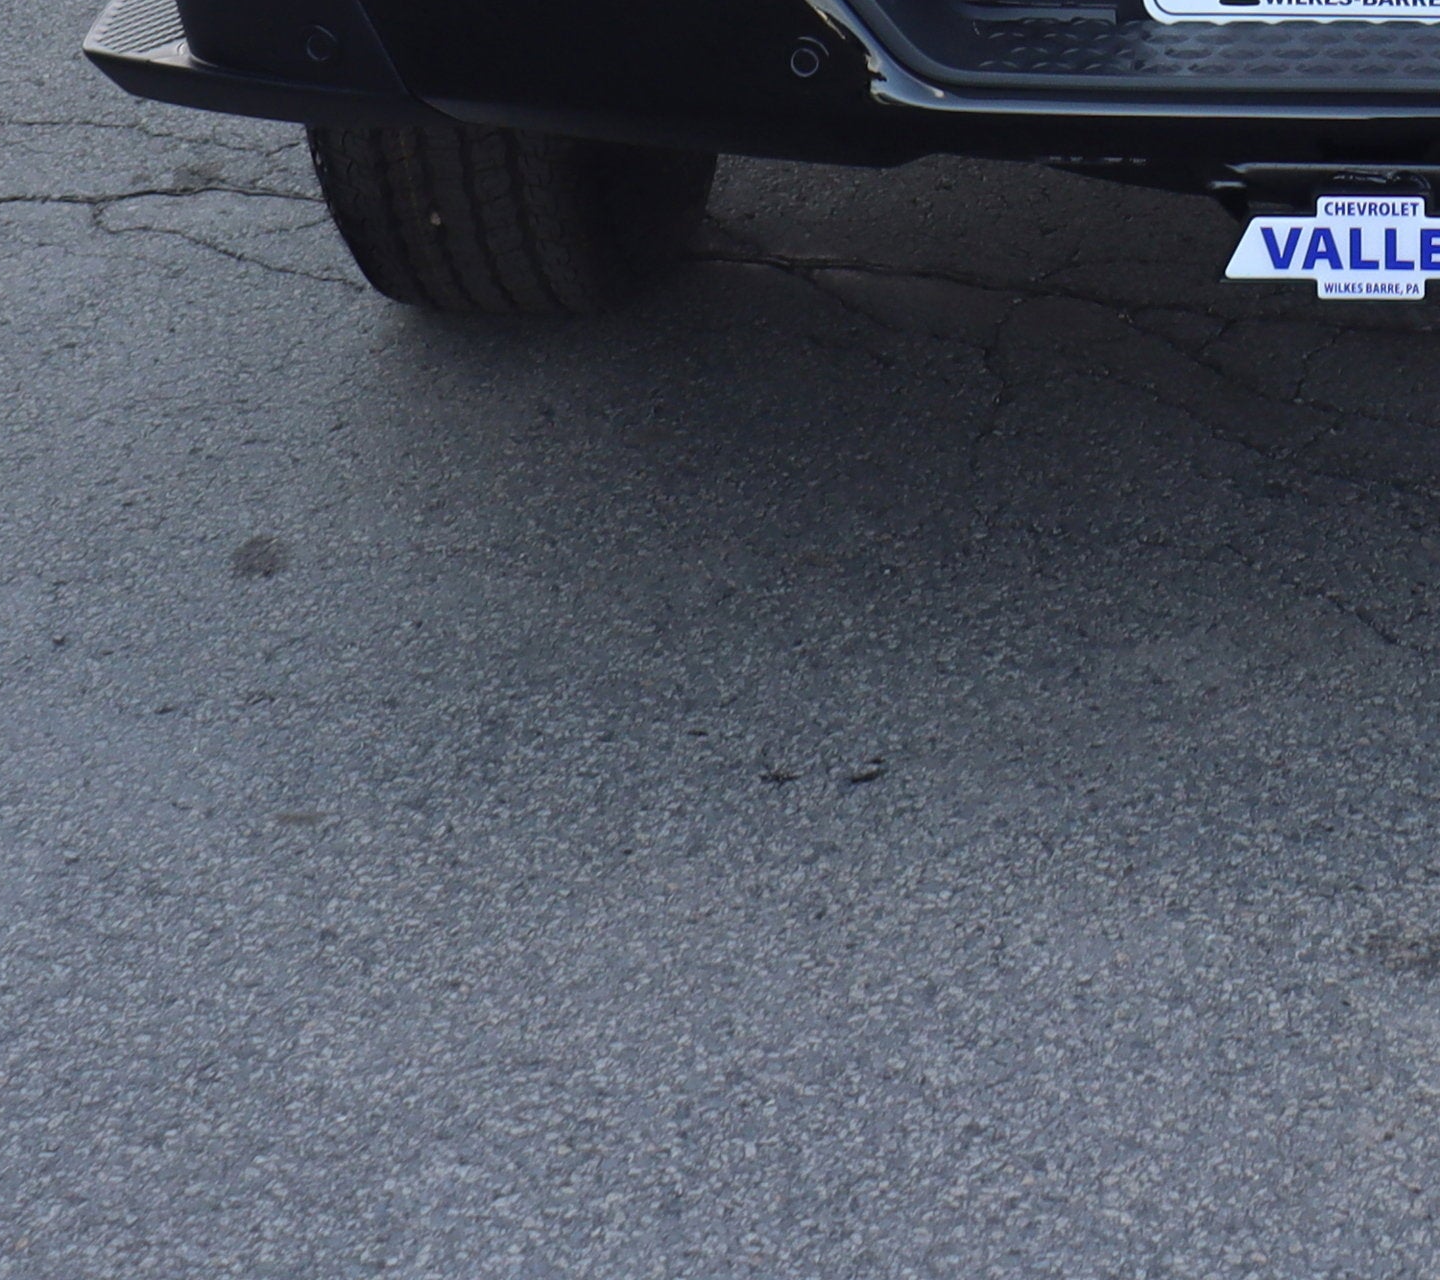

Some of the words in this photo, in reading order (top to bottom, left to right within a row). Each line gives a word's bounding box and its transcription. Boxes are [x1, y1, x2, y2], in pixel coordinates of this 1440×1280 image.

[1323, 201, 1420, 217] CHEVROLET
[1323, 282, 1364, 294] WILKES
[1366, 282, 1404, 296] BARRE,
[1406, 283, 1420, 295] PA
